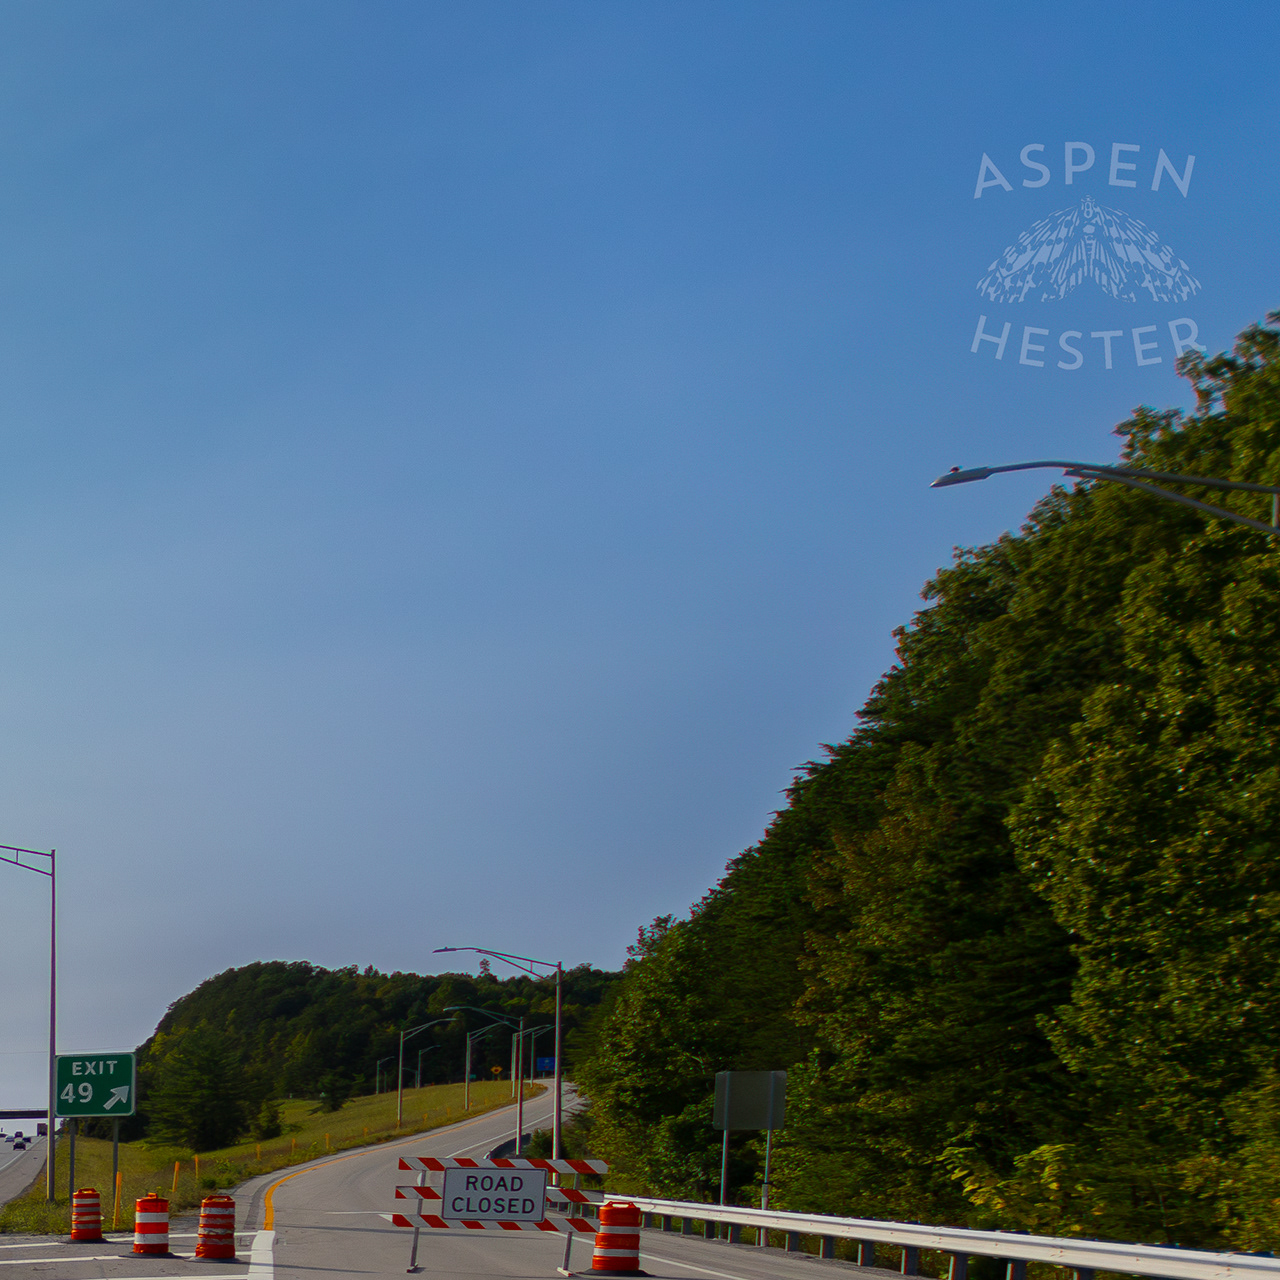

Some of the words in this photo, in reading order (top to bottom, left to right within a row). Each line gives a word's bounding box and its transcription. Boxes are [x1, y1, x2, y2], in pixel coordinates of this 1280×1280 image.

[72, 1061, 118, 1076] EXIT
[60, 1082, 93, 1103] 49
[465, 1175, 524, 1192] ROAD
[451, 1197, 535, 1215] CLOSED
